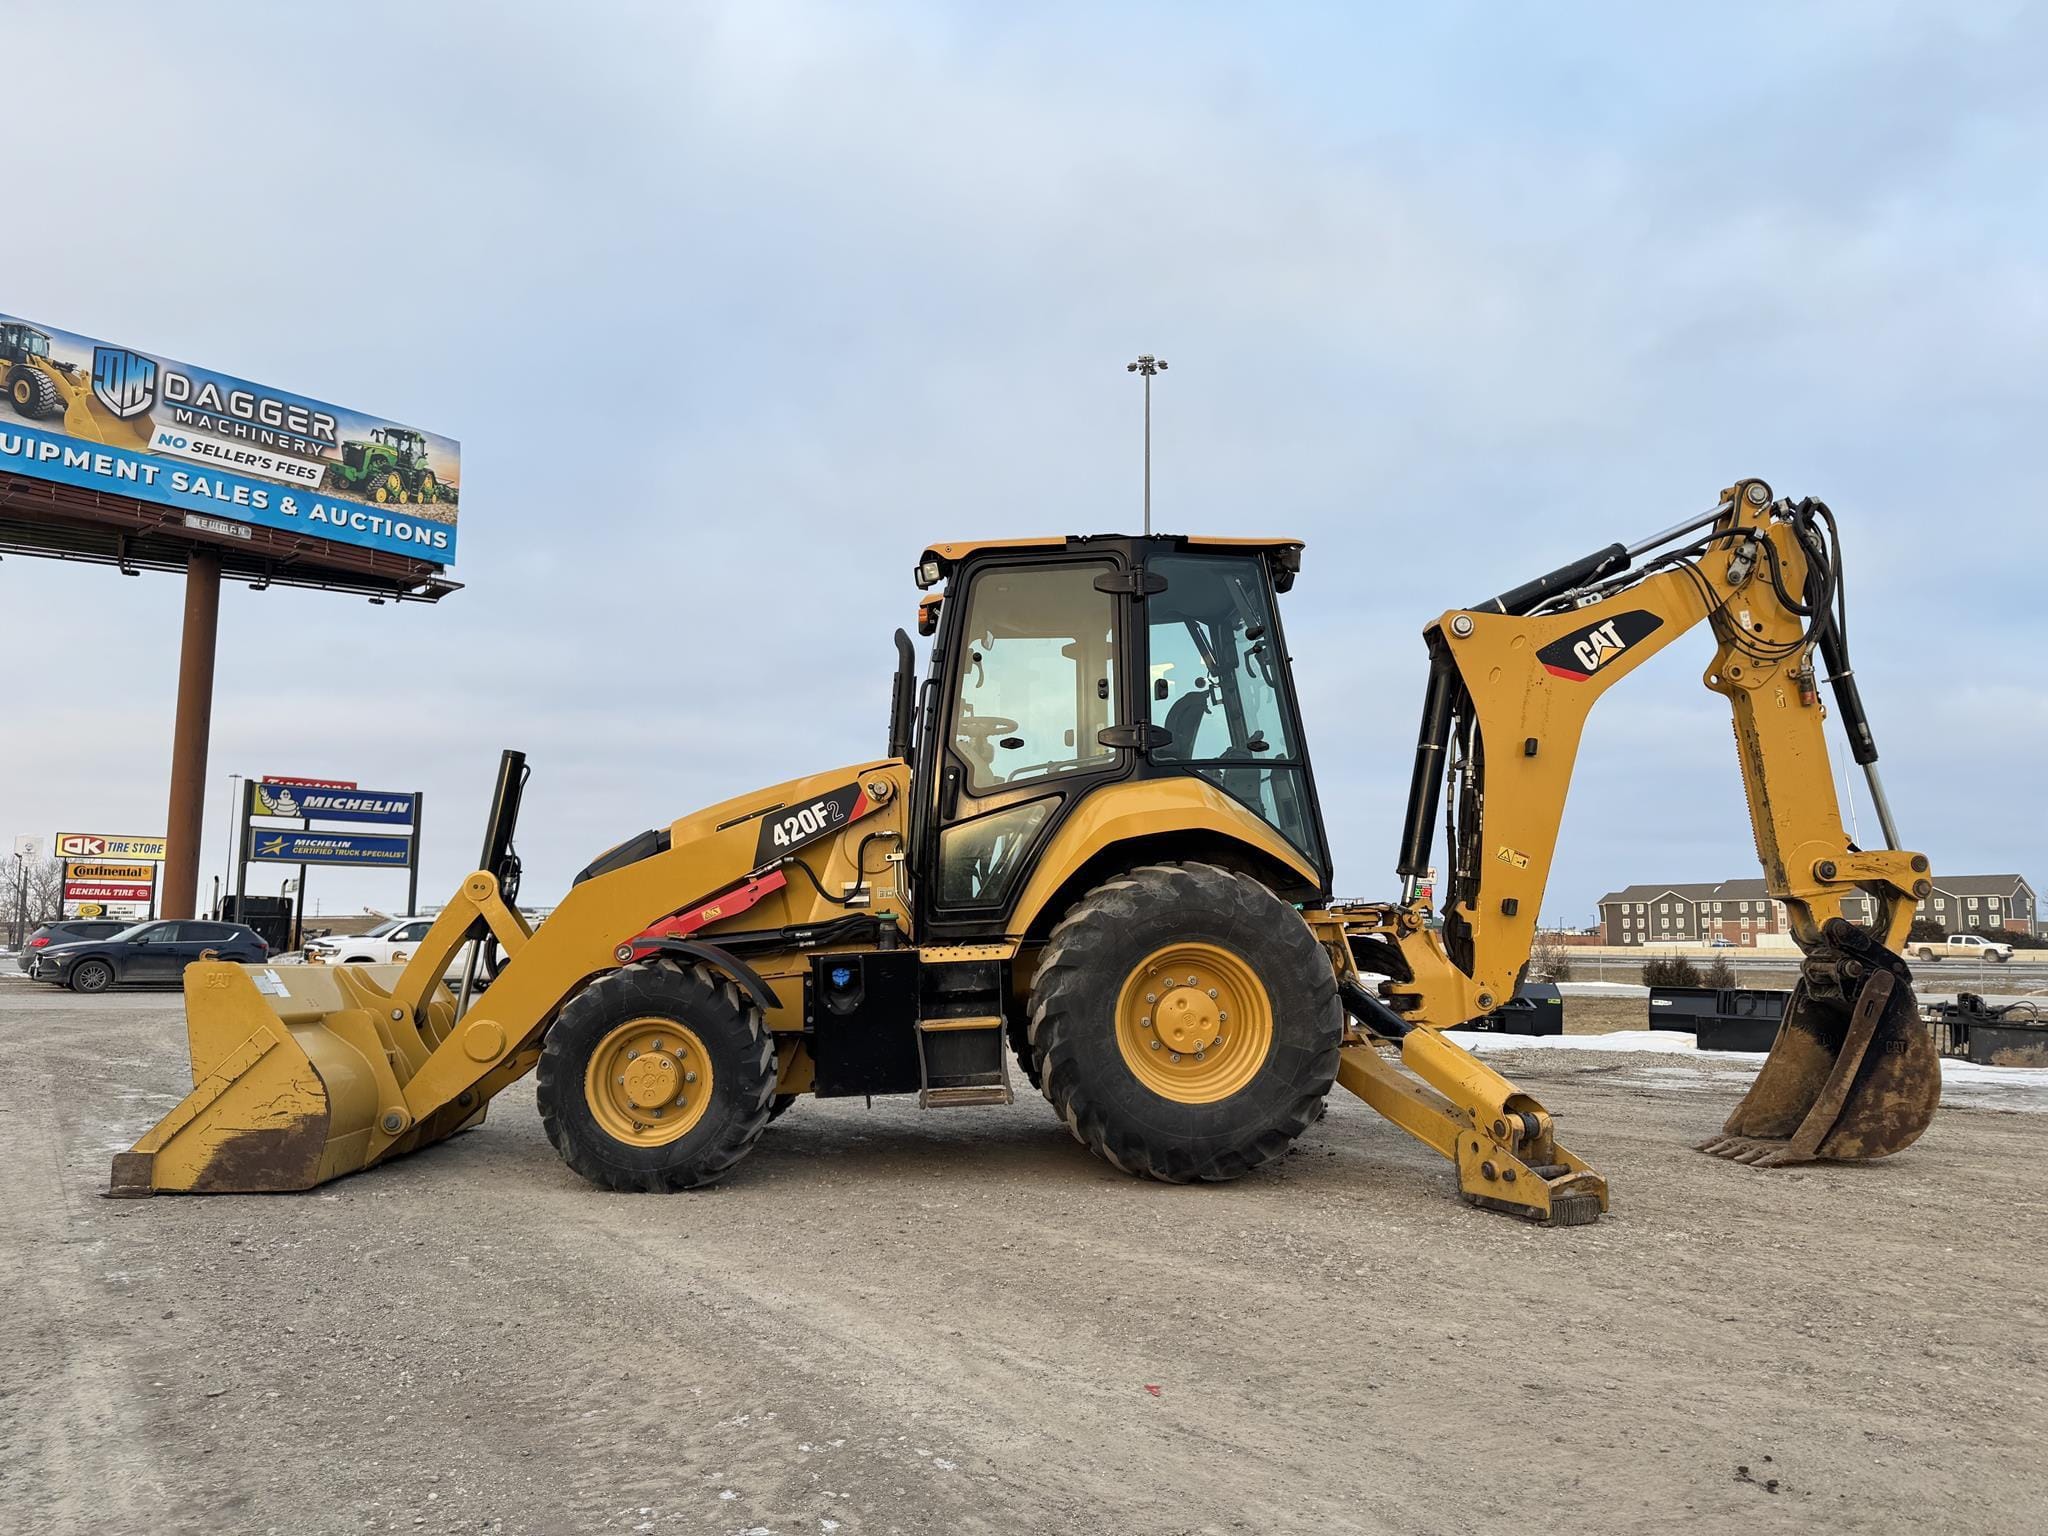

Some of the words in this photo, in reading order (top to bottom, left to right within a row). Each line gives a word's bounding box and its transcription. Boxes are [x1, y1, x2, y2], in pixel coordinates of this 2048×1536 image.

[165, 372, 336, 442] DAGGER
[175, 408, 325, 457] MACHINERY
[157, 433, 188, 450] NO
[191, 441, 273, 470] SELLER'S
[276, 460, 318, 480] FEES
[171, 472, 270, 509] SALES
[280, 496, 299, 517] &
[308, 503, 449, 549] AUCTIONS
[1573, 620, 1626, 671] CAT
[303, 796, 409, 814] MICHELIN
[64, 838, 104, 855] OK
[108, 842, 130, 853] TIRE
[132, 843, 163, 854] STORE
[294, 839, 352, 849] MICHELIN
[292, 848, 333, 856] CERTIFIED
[334, 849, 361, 857] TRUCK
[361, 851, 406, 860] SPECIALIST
[74, 866, 142, 878] Continental
[69, 887, 111, 896] GENERAL
[113, 889, 134, 897] TIRE
[206, 973, 233, 988] CAT
[1886, 1040, 1906, 1054] CAT
